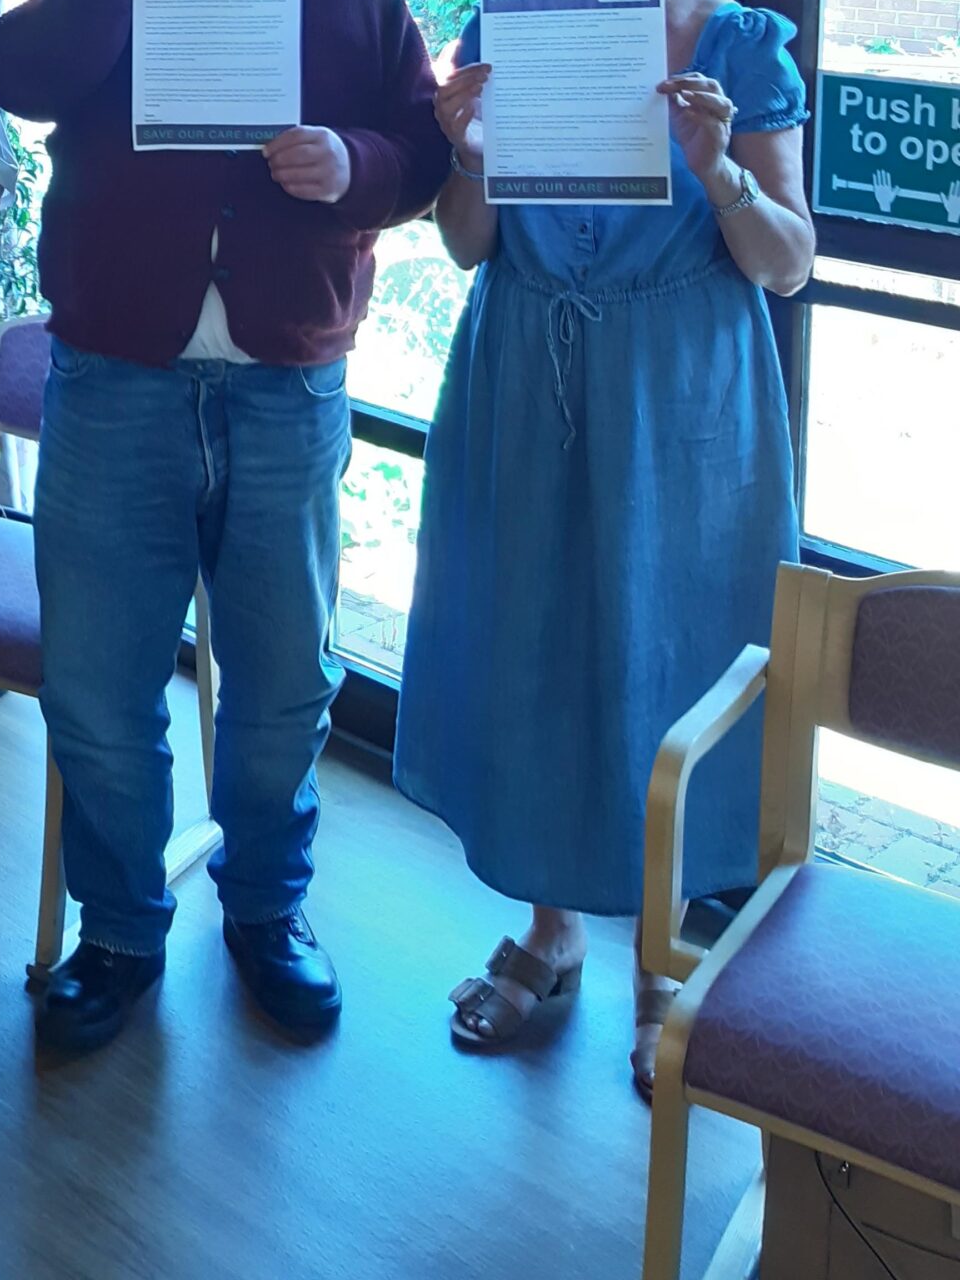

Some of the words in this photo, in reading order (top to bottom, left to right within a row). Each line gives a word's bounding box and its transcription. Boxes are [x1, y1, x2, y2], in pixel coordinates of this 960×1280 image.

[839, 85, 936, 128] Push
[143, 129, 176, 140] SAVE
[178, 129, 204, 140] OUR
[208, 129, 241, 140] CARE
[850, 123, 887, 155] to
[496, 183, 530, 193] SAVE
[535, 183, 563, 193] OUR
[568, 183, 603, 193] CARE
[610, 183, 658, 193] HOMES
